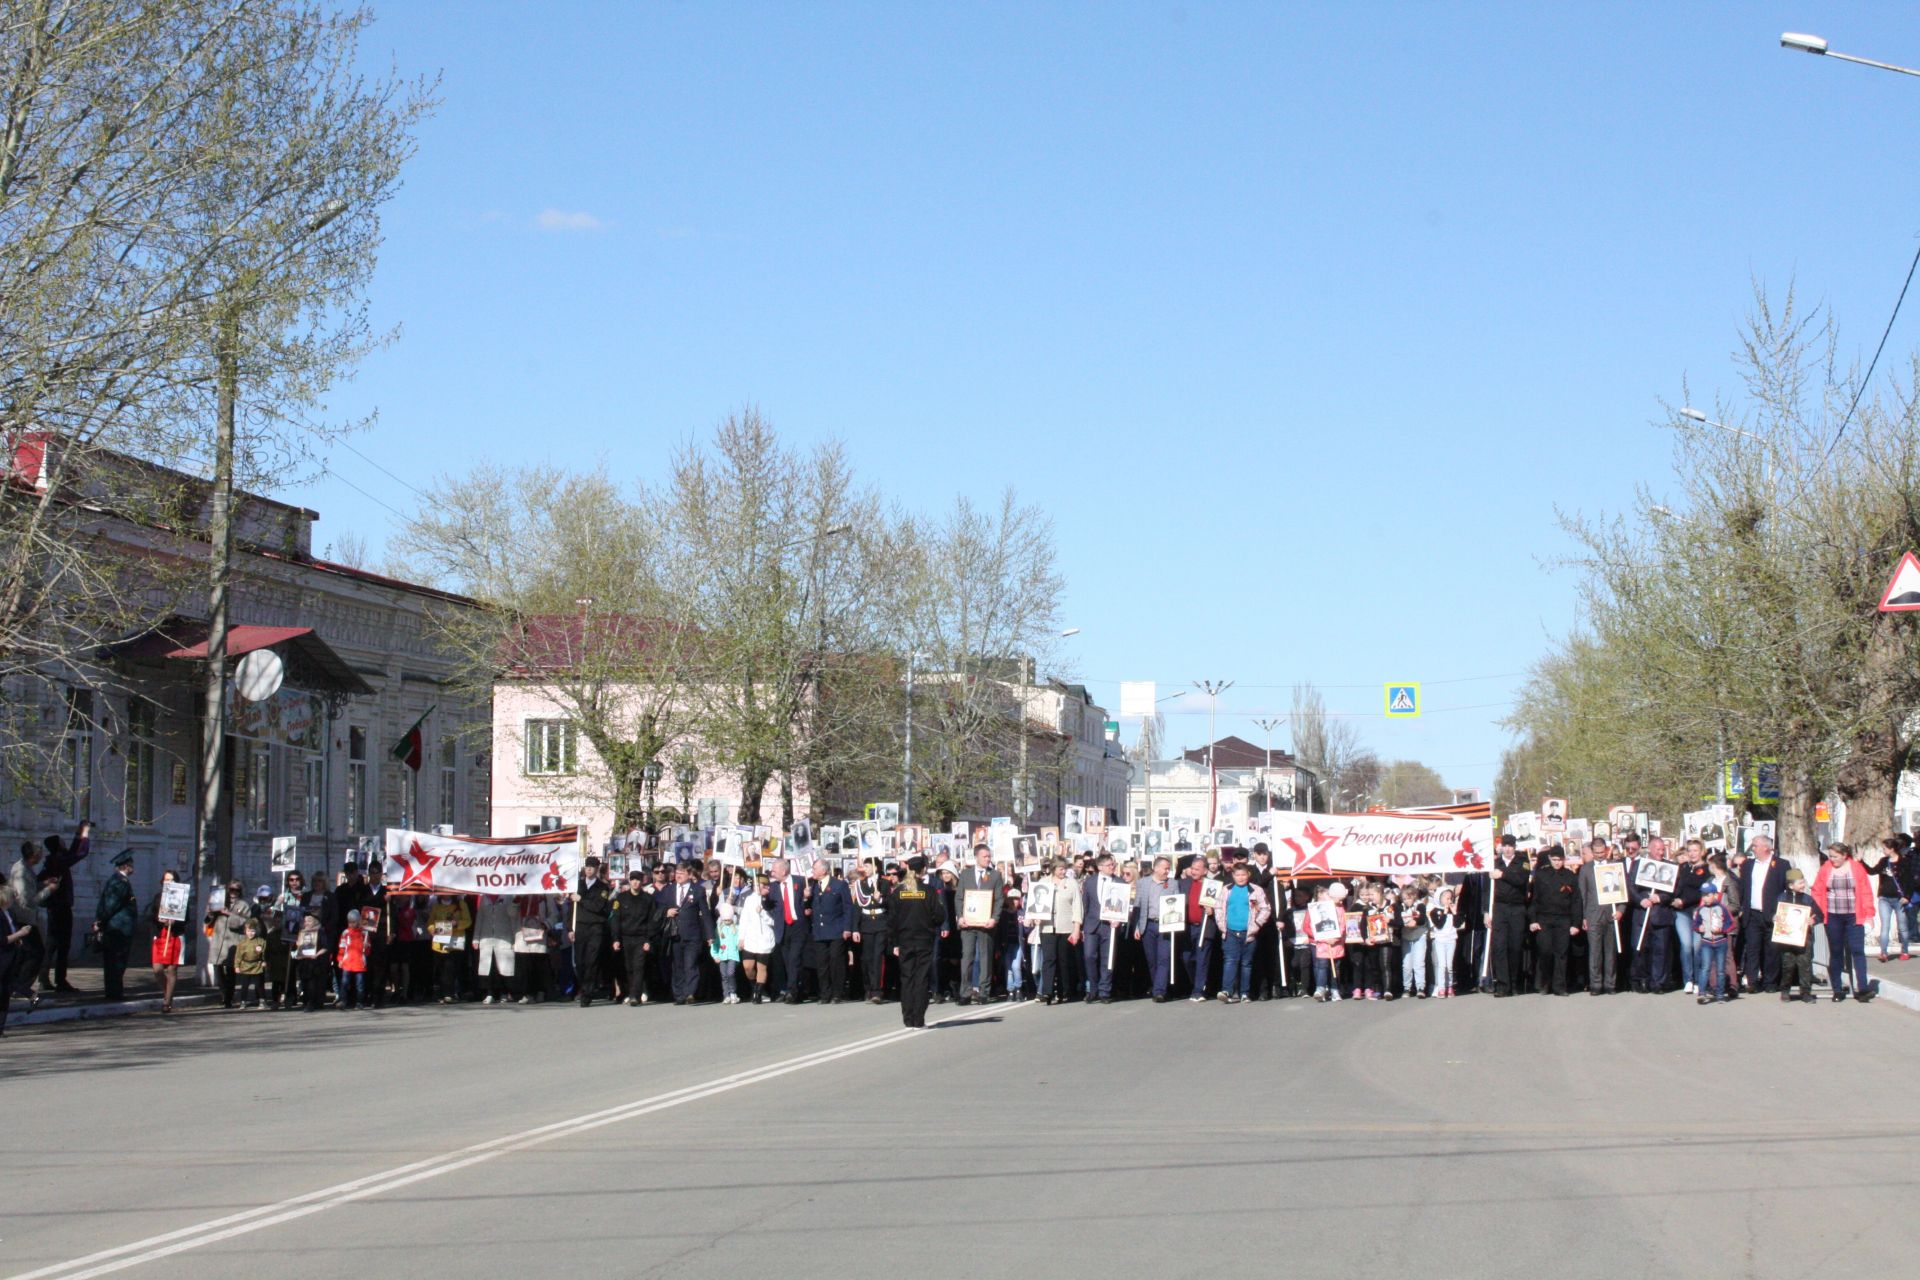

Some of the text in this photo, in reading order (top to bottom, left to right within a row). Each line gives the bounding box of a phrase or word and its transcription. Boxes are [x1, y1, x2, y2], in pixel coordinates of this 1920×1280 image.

[1341, 823, 1472, 848] Бессмертный
[442, 847, 560, 871] Бессмертный
[1379, 851, 1437, 867] ПОЛК
[476, 872, 528, 887] ПОЛК
